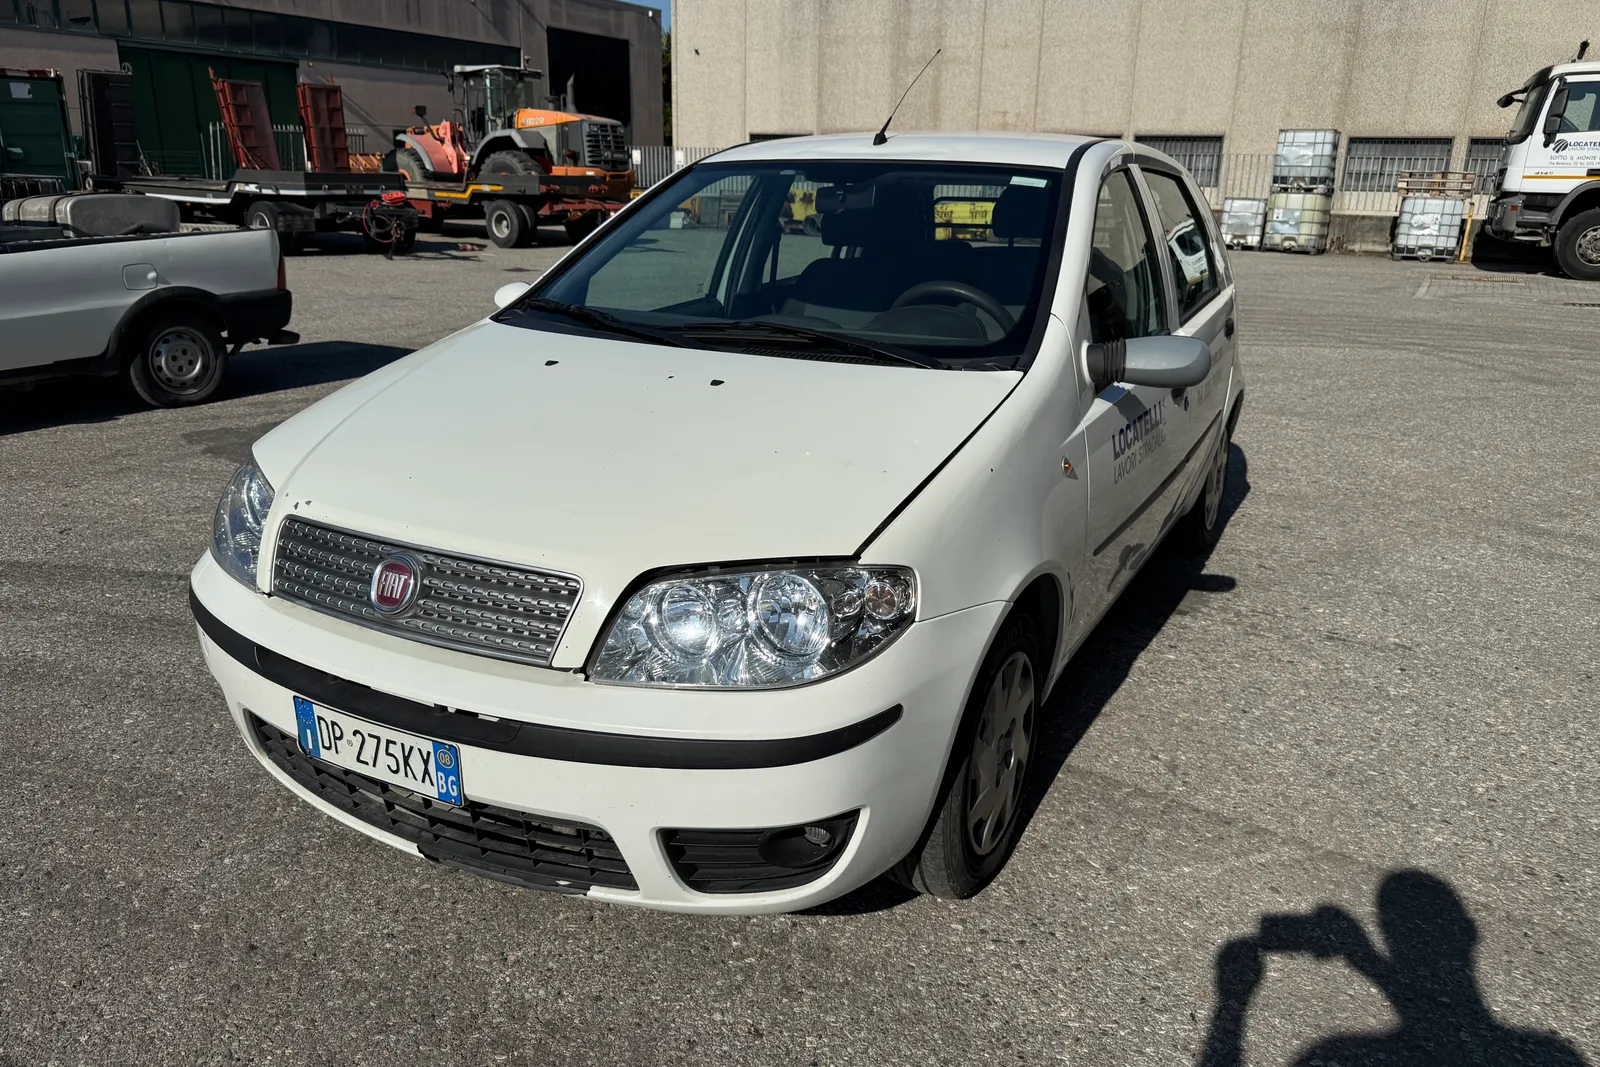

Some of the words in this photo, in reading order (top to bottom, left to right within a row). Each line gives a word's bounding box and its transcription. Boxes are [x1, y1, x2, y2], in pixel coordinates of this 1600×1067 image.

[1112, 401, 1162, 461] LOCATELLI
[1114, 450, 1136, 485] LAVORI
[378, 570, 408, 599] FIAT
[316, 714, 344, 755] DP
[352, 729, 435, 787] 275KX
[439, 752, 451, 765] 08
[437, 771, 458, 797] BG
